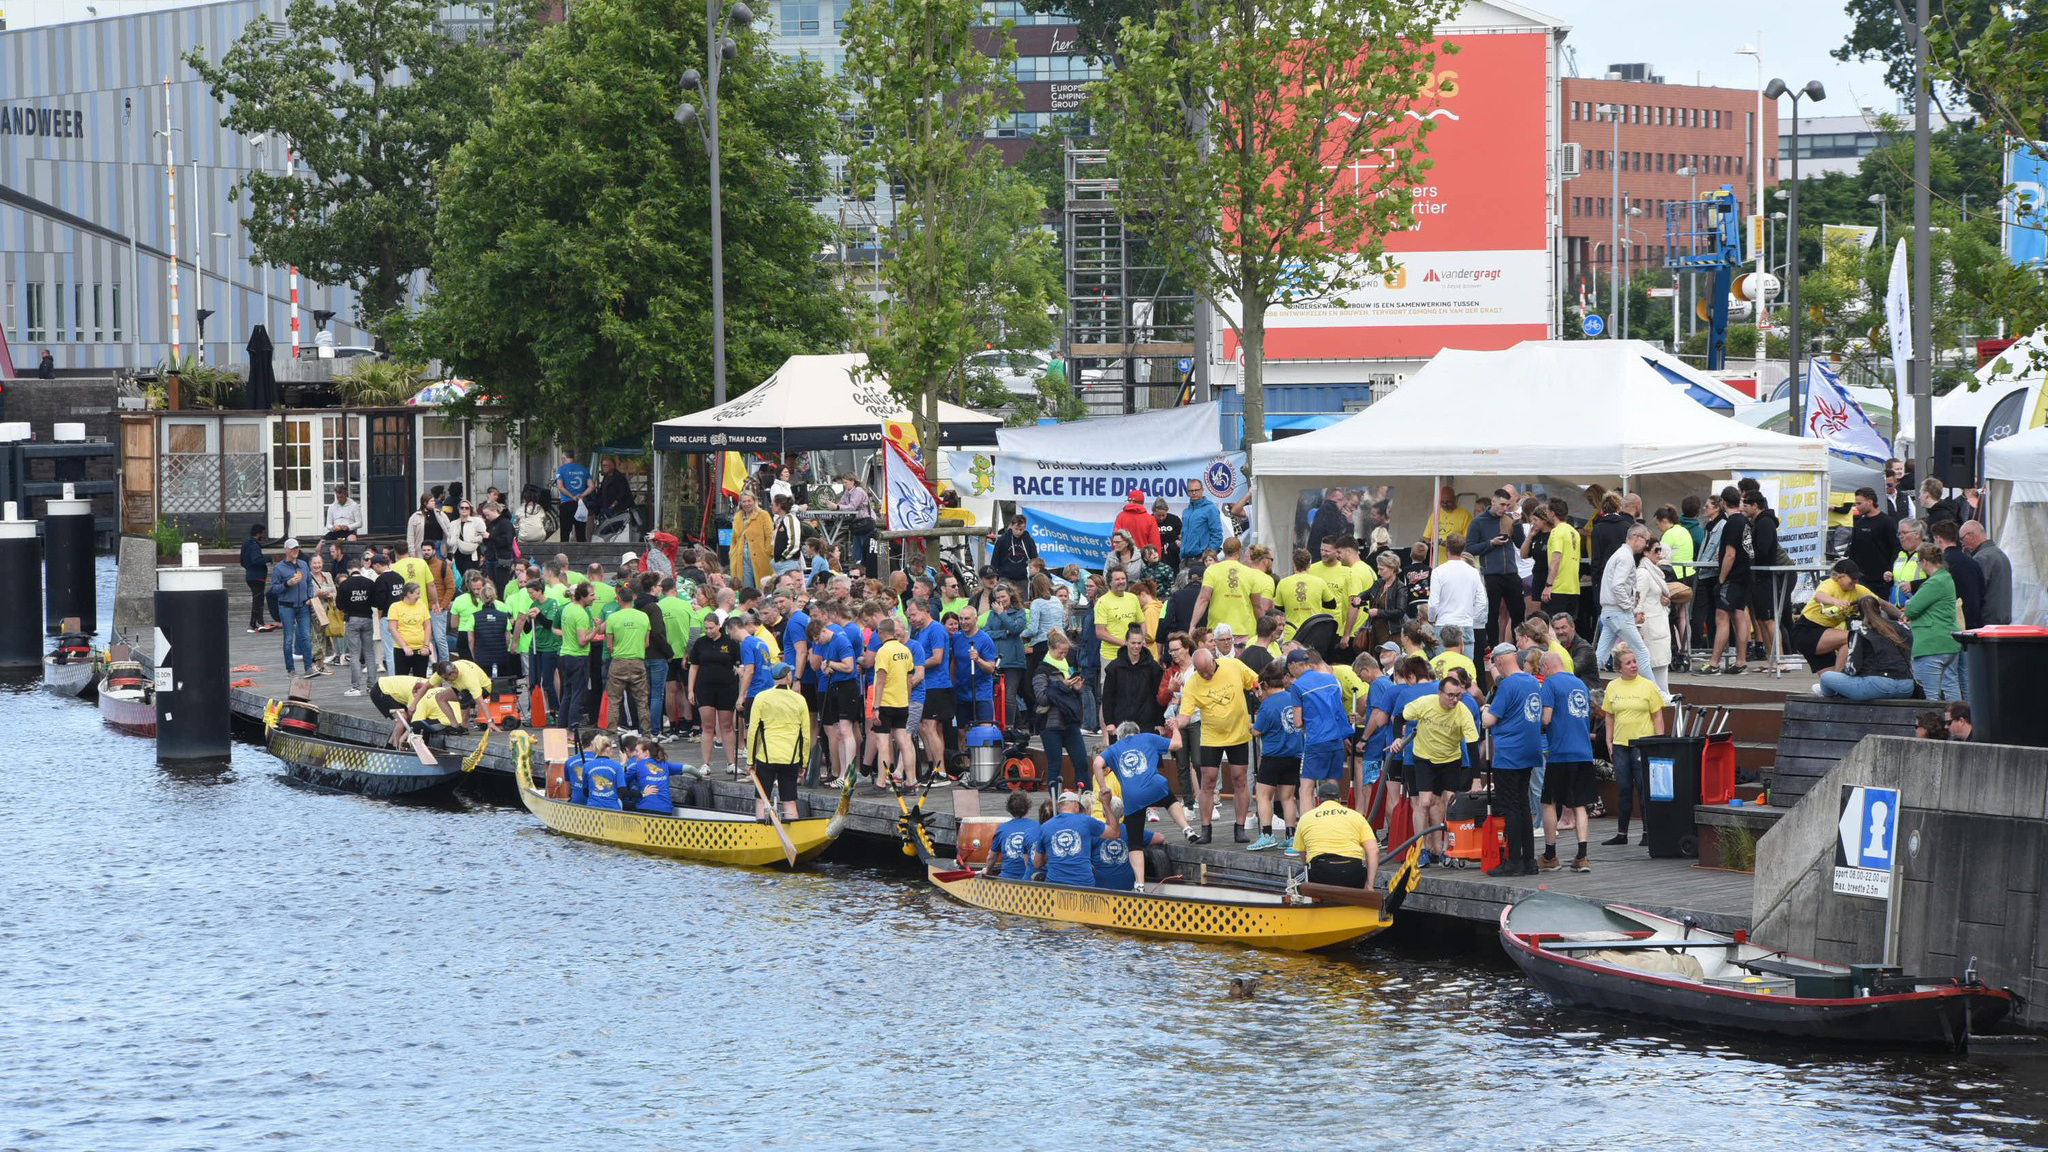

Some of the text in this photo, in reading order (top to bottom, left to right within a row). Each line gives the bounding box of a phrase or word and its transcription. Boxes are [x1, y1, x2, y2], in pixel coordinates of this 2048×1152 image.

[1051, 84, 1093, 92] EUROP
[1051, 92, 1086, 100] CAMPING
[1051, 100, 1079, 108] GROUP
[1, 106, 84, 139] ANDWEER
[1441, 268, 1502, 281] vandergragt
[850, 432, 882, 442] TIJD VO
[1013, 476, 1064, 495] RACE
[1068, 477, 1107, 496] THE
[1111, 477, 1191, 498] DRAGON
[1031, 524, 1069, 541] Schoon
[1070, 534, 1103, 548] water,
[1083, 548, 1100, 558] we
[892, 652, 909, 661] CREW
[1315, 808, 1348, 818] CREW
[1836, 870, 1848, 878] sport
[1847, 883, 1865, 892] breedte
[1057, 891, 1078, 911] UNITED
